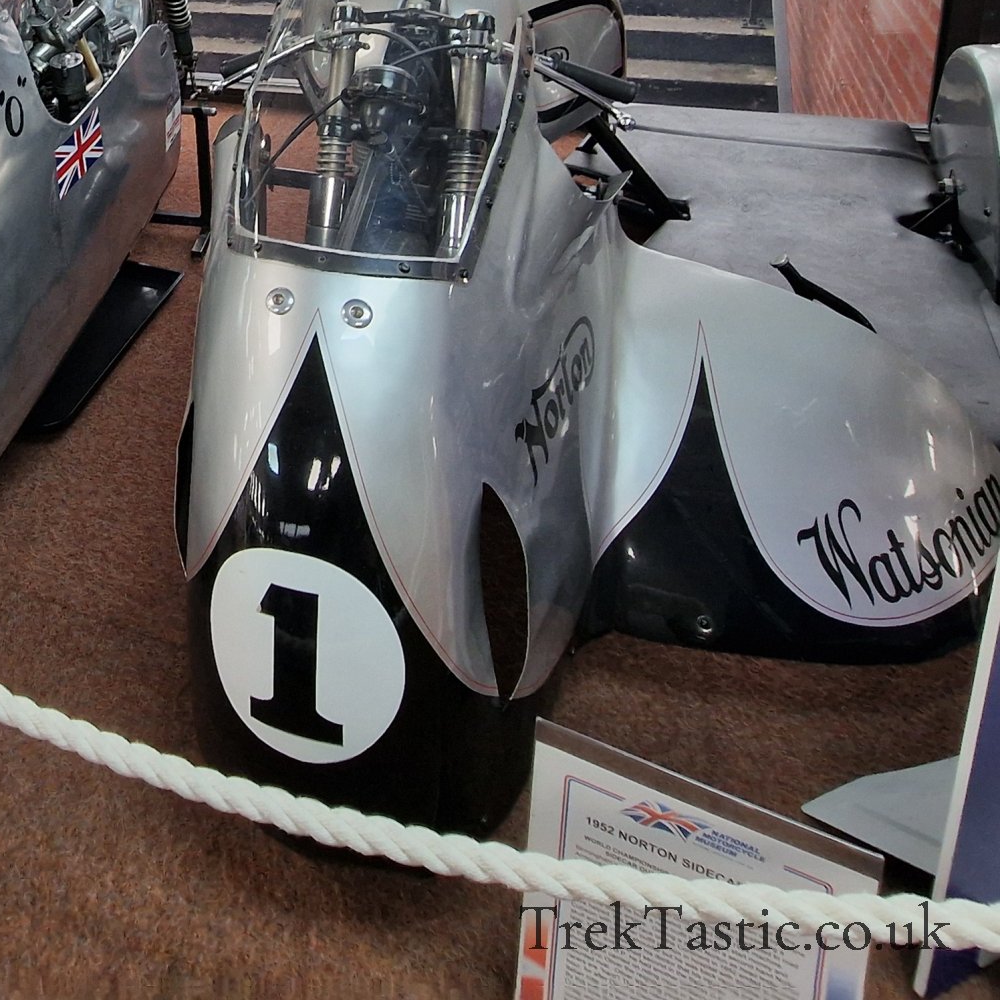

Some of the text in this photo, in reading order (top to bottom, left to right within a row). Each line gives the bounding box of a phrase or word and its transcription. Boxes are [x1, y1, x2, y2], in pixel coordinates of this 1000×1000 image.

[515, 316, 595, 487] Norton
[797, 474, 1000, 609] Watsonian
[250, 583, 343, 746] 1
[584, 835, 611, 851] WORLD
[586, 816, 615, 836] 1952
[618, 829, 679, 863] NORTON
[681, 858, 743, 885] SIDECA
[695, 836, 737, 857] MUSEUM
[702, 832, 766, 863] MOTORCYCLE
[712, 830, 760, 854] NATIONAL
